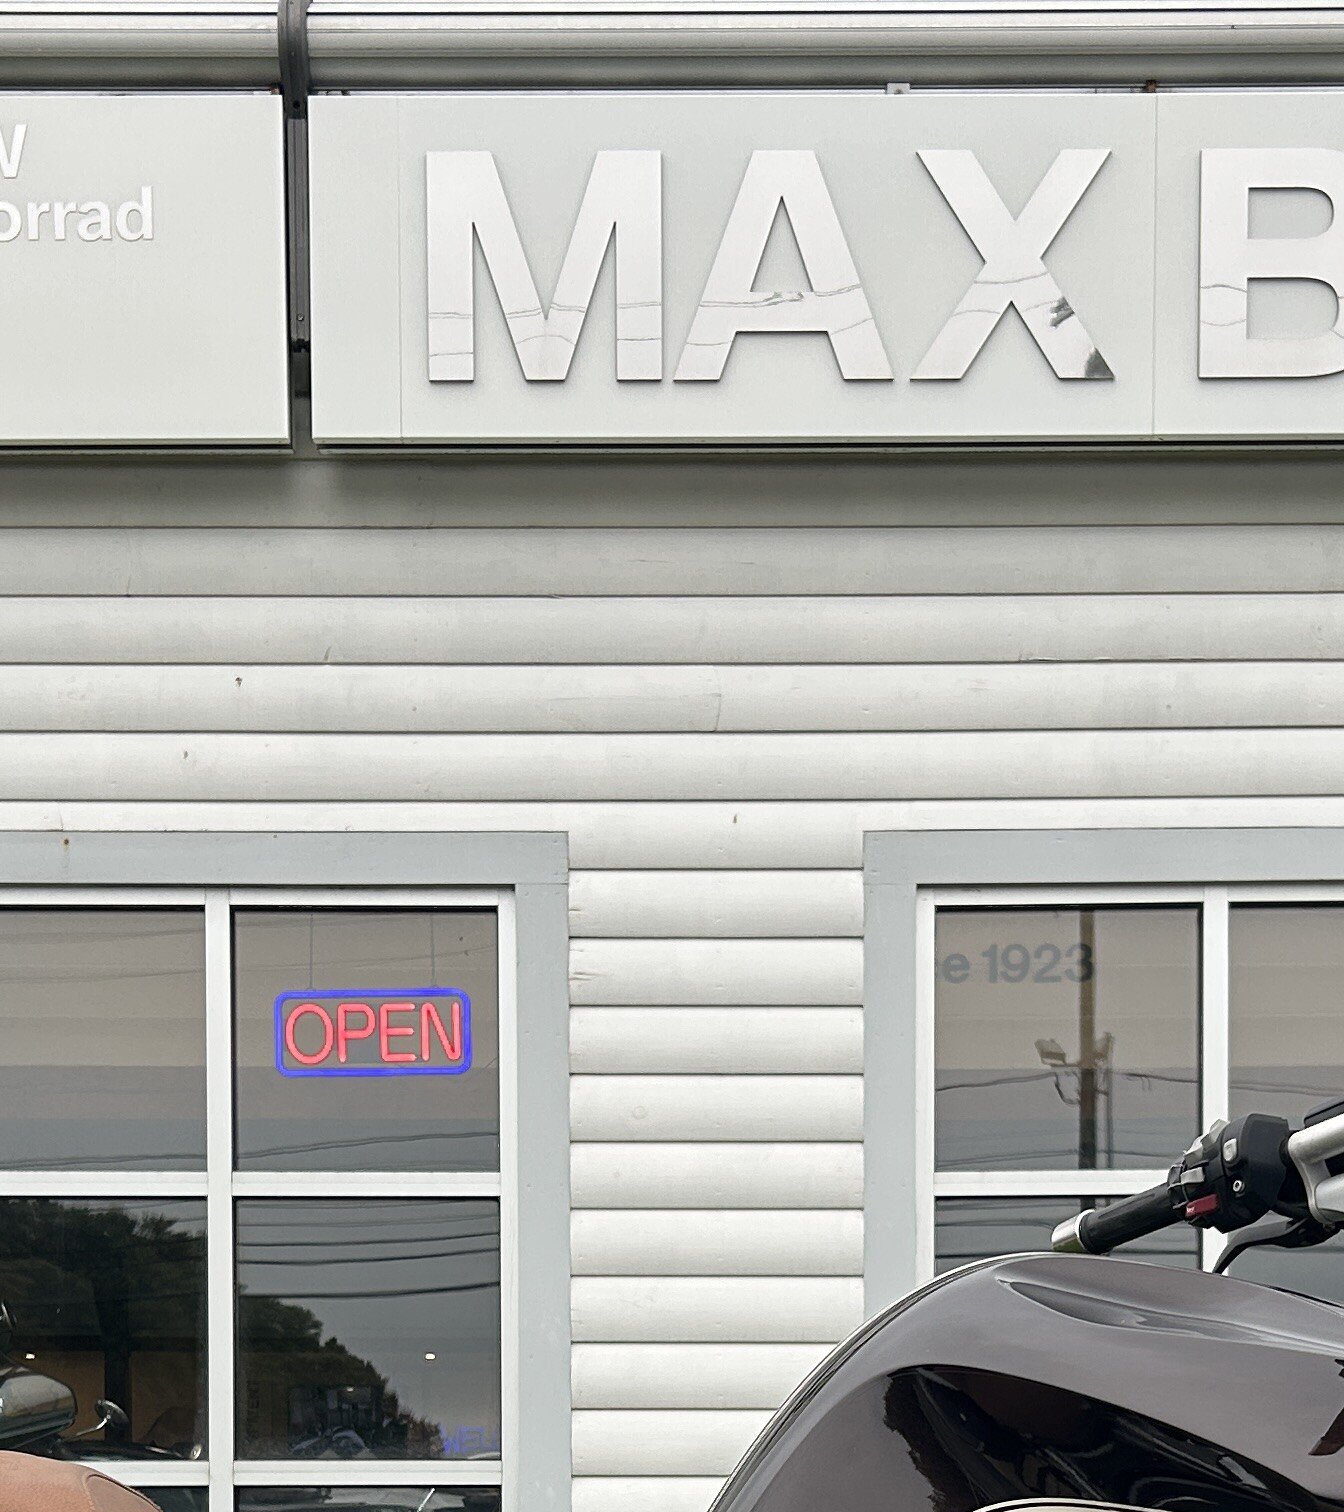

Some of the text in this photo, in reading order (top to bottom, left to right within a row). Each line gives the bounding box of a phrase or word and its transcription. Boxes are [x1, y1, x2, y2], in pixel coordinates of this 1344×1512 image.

[425, 148, 1116, 382] MAX
[982, 943, 1094, 984] 1923
[285, 1002, 462, 1064] OPEN
